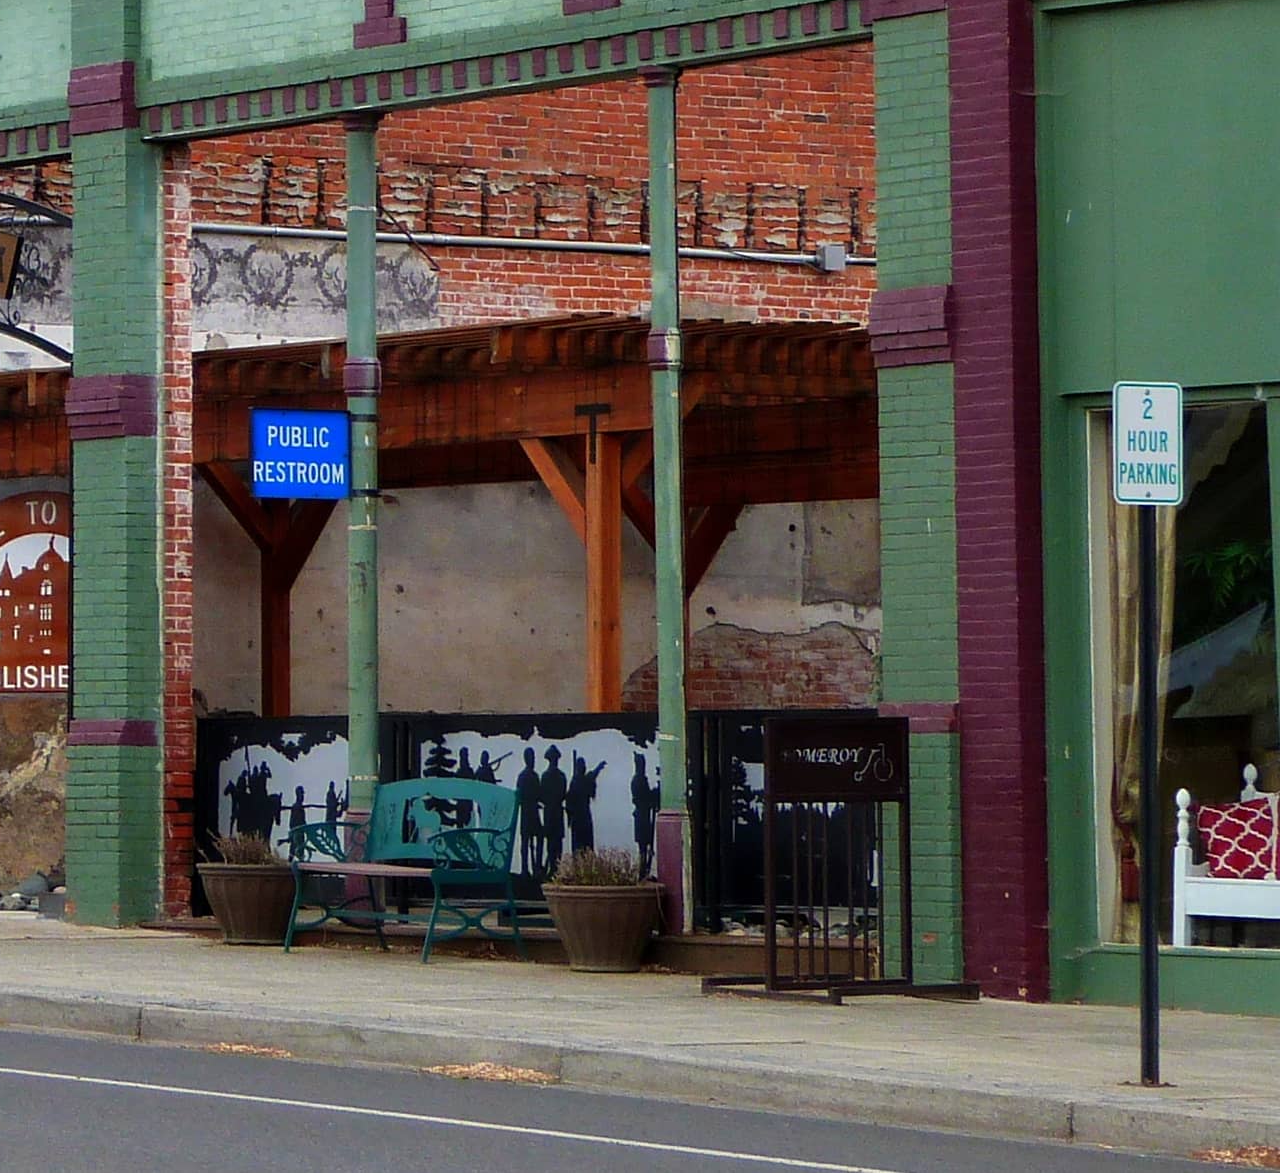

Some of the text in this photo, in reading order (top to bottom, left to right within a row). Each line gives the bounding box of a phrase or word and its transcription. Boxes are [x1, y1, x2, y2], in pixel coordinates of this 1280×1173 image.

[1143, 398, 1153, 420] 2
[268, 426, 329, 448] PUBLIC
[1127, 430, 1168, 452] HOUR
[253, 461, 345, 485] RESTROOM
[1120, 463, 1177, 485] PARKING
[26, 501, 56, 525] TO
